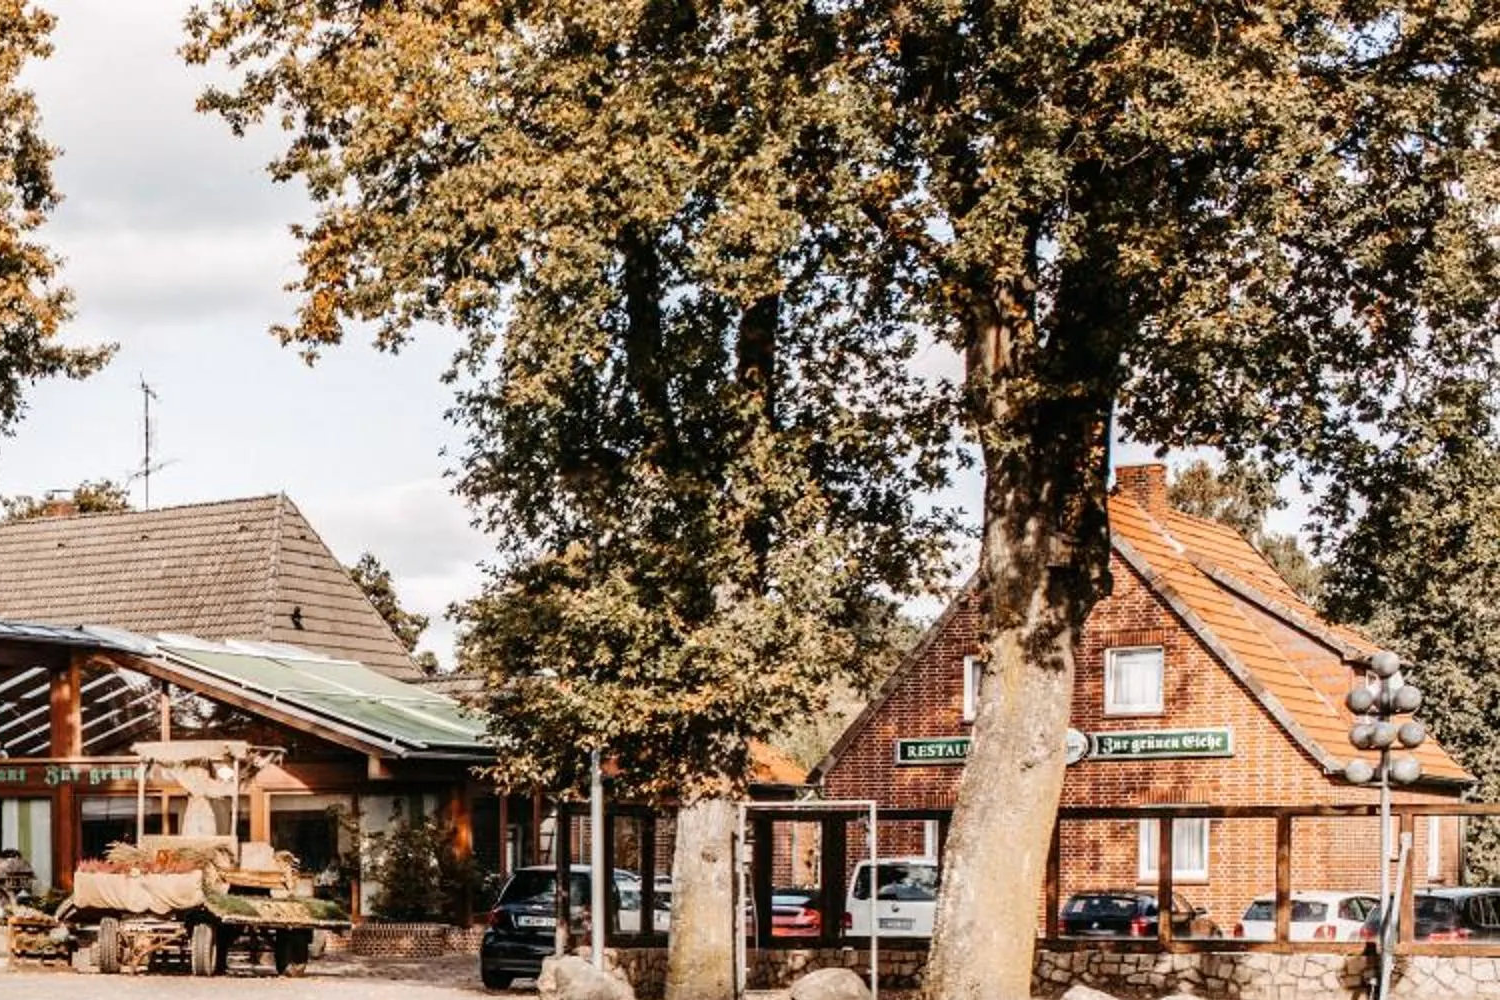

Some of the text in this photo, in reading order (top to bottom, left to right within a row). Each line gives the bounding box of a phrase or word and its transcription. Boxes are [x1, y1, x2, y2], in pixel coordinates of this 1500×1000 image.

[907, 744, 970, 757] RESTAU
[1102, 734, 1222, 753] Zur grünen Eiche
